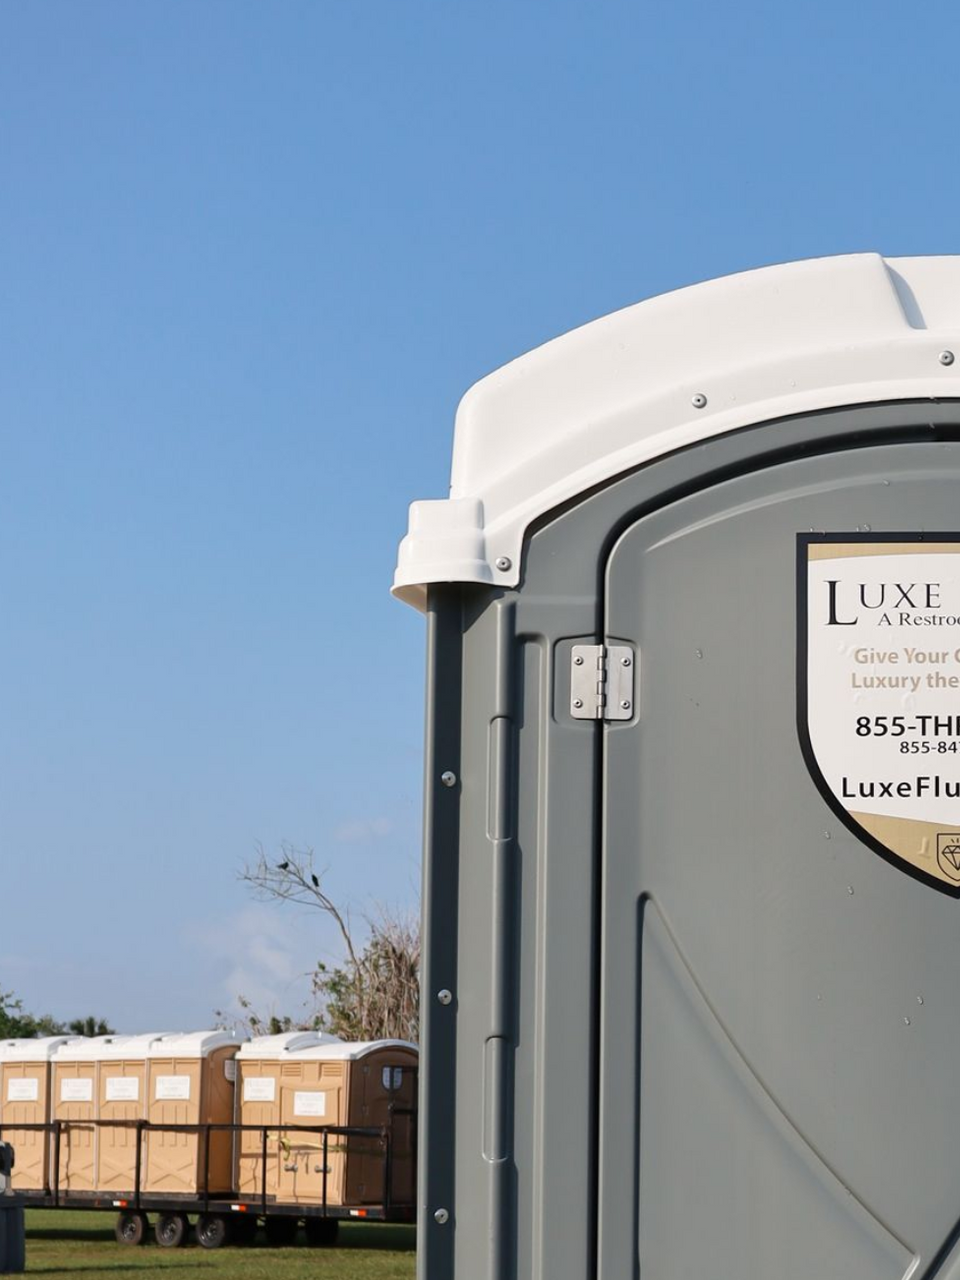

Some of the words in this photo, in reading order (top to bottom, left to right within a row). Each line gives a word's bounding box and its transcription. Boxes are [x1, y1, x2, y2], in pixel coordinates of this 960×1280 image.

[823, 580, 941, 626] LUXE
[877, 612, 892, 626] A
[854, 648, 899, 665] Give
[903, 648, 949, 665] Your
[851, 673, 921, 693] Luxury
